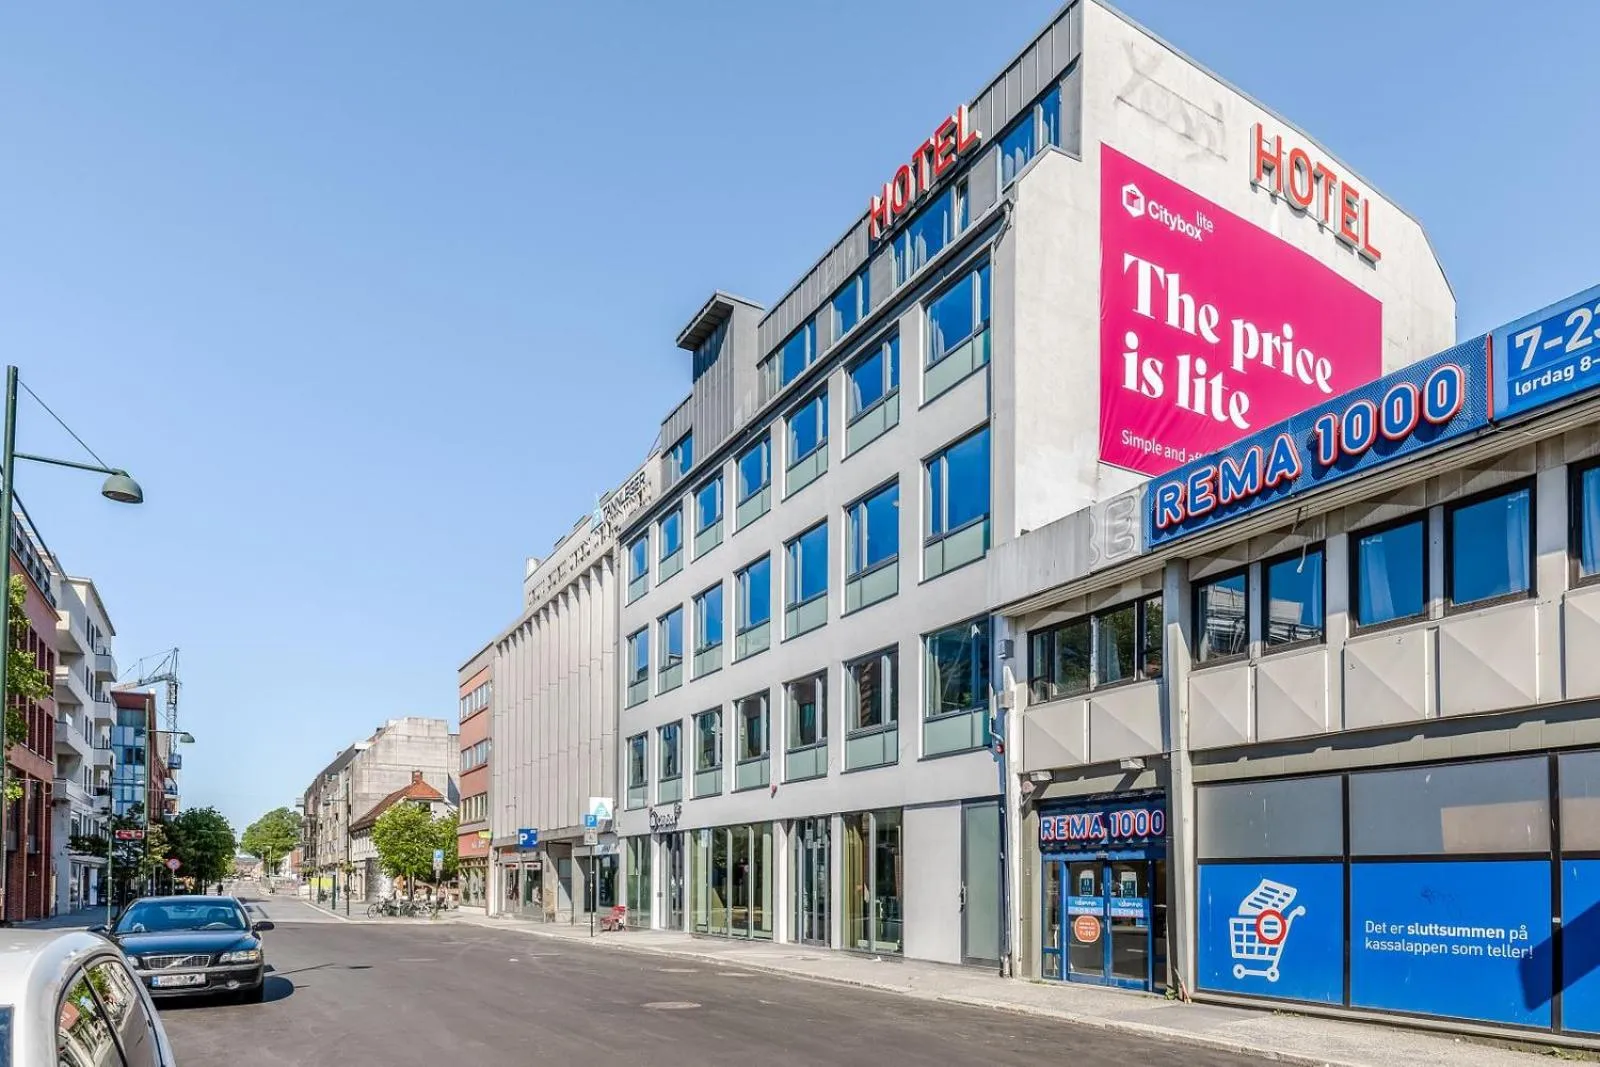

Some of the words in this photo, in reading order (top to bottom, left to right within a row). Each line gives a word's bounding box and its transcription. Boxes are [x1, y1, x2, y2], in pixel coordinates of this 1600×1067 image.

[869, 104, 982, 240] HOTEL
[1250, 122, 1382, 262] HOTEL
[1148, 200, 1203, 242] Citybox
[1196, 210, 1214, 233] lite
[1122, 253, 1221, 344] The
[1230, 318, 1334, 394] price
[1515, 303, 1600, 371] 7-2
[1121, 331, 1165, 399] is
[1175, 353, 1251, 430] lite
[1515, 364, 1575, 396] lørdag
[1121, 429, 1163, 455] Simple
[1164, 446, 1186, 463] and
[1155, 432, 1302, 530] REMA
[1314, 362, 1466, 467] 1000
[519, 832, 528, 845] P
[1040, 813, 1107, 841] REMA
[1109, 808, 1165, 838] 1000
[1365, 920, 1386, 934] Det
[1390, 924, 1404, 935] er
[1407, 922, 1505, 939] sluttsummen
[1509, 924, 1528, 943] på
[1365, 937, 1448, 956] kassalappen
[1452, 944, 1483, 956] som
[1487, 943, 1533, 959] teller!
